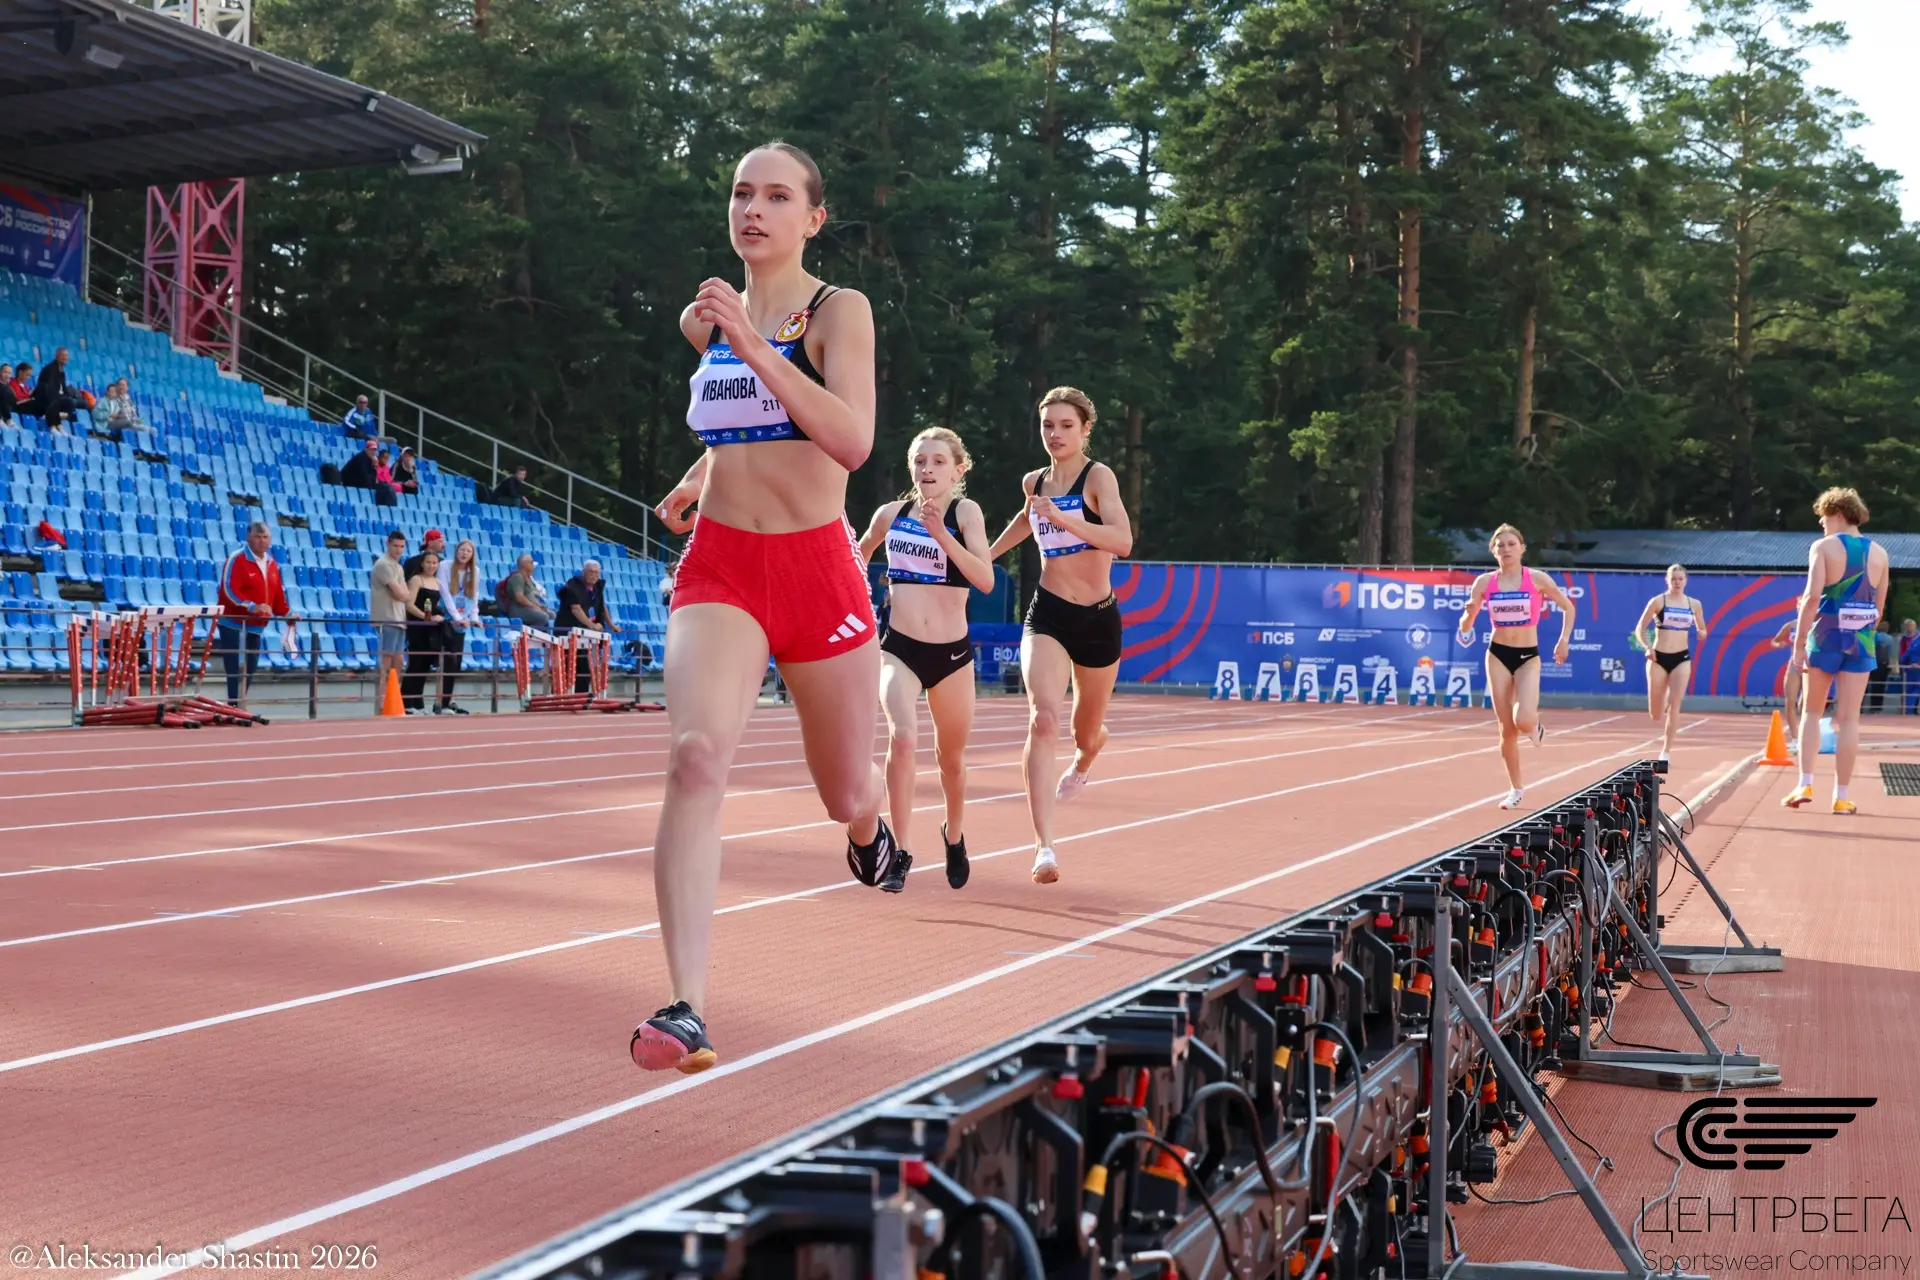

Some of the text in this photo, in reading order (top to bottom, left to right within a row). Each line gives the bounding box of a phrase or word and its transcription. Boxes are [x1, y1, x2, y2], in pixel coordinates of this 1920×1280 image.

[702, 377, 757, 402] ИВАНОВА
[889, 539, 939, 561] АНИСКИНА
[1358, 583, 1425, 610] ПСБ
[1263, 632, 1295, 645] ПСБ
[1221, 669, 1466, 697] 8 7 6 5 4 3 2
